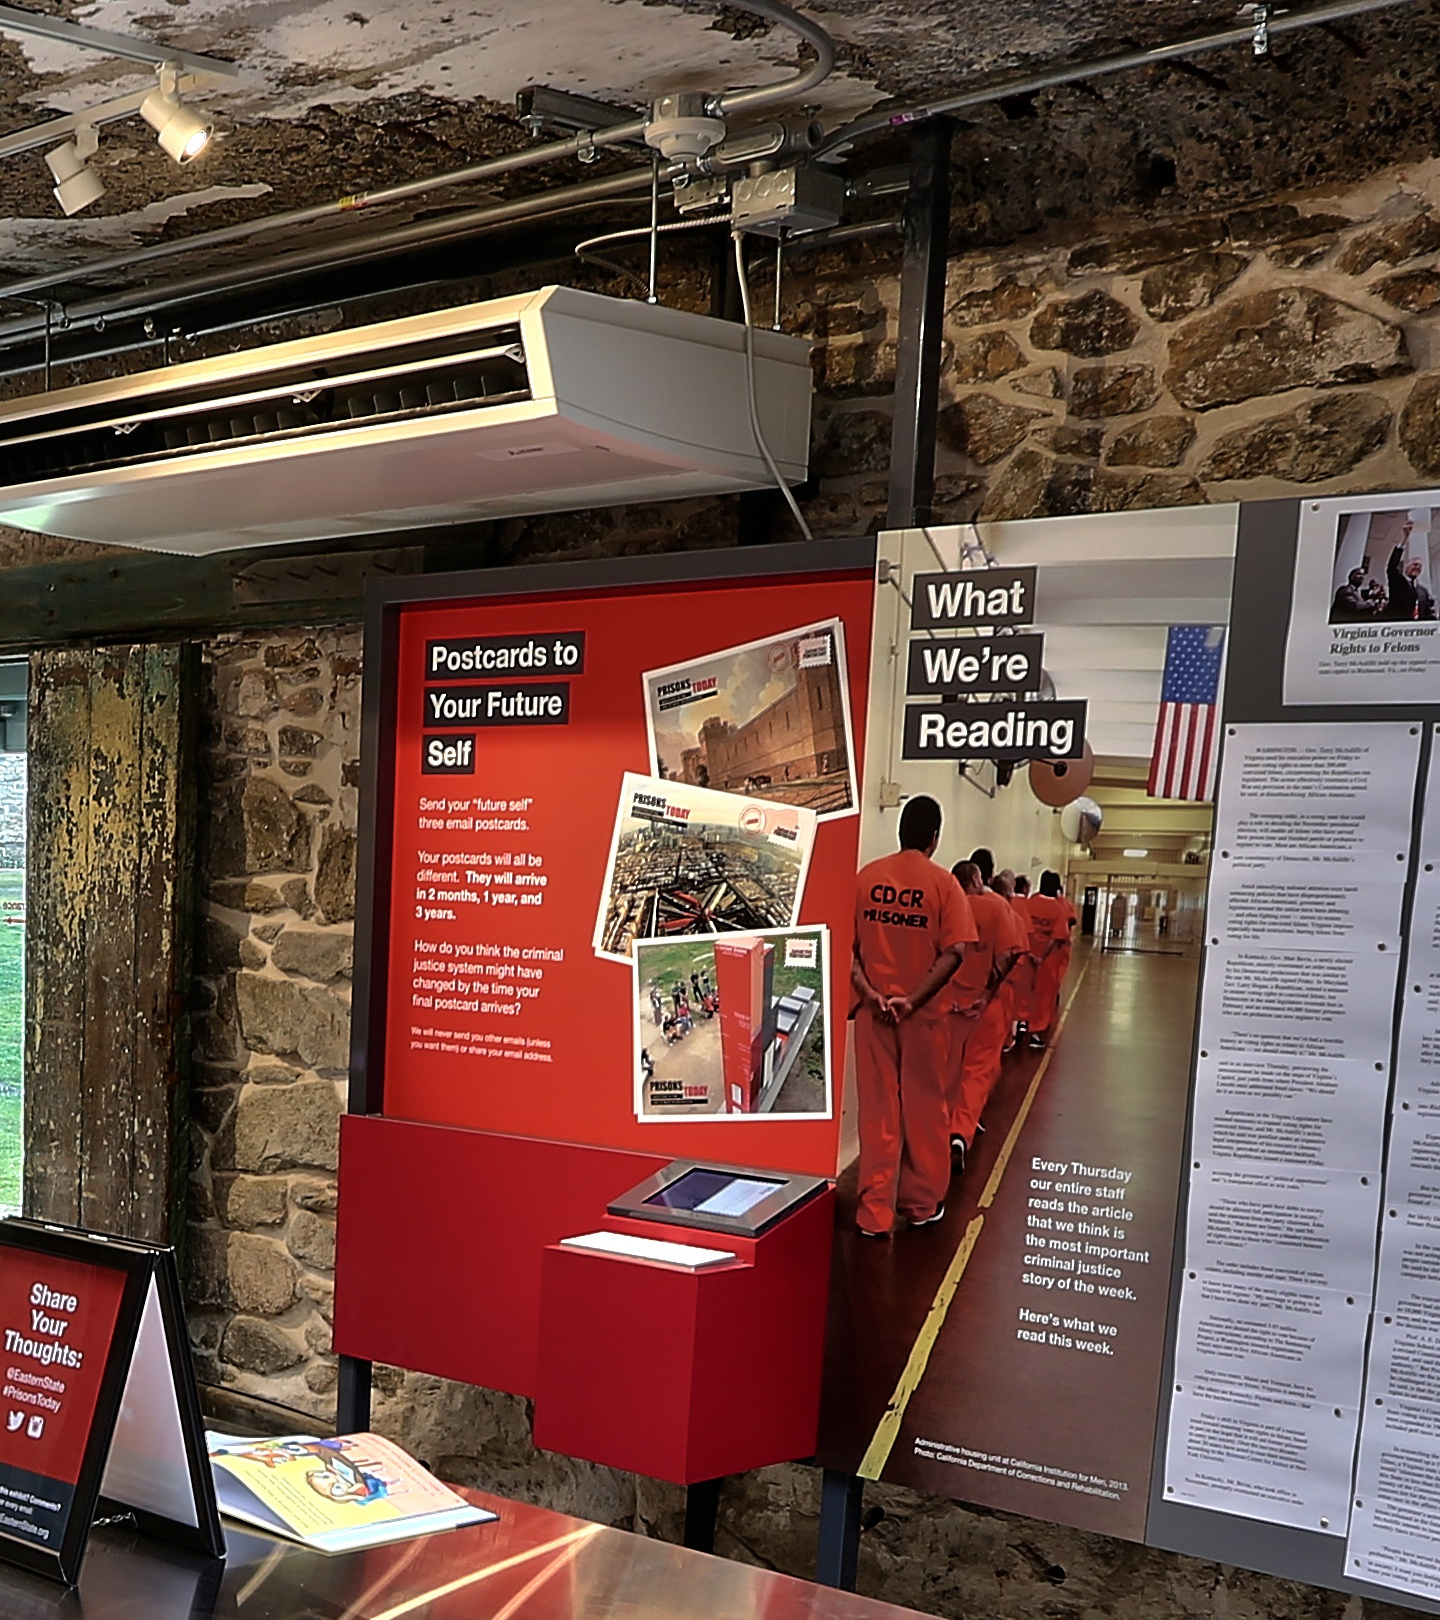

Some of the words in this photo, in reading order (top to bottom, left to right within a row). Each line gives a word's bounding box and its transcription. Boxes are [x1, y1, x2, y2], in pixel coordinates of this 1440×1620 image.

[927, 581, 1025, 618] What
[1332, 627, 1378, 641] Virginia
[1380, 625, 1437, 638] Governor
[432, 640, 547, 671] Postcards
[553, 640, 578, 666] to
[1330, 642, 1367, 656] Rights
[1369, 643, 1380, 653] to
[1383, 642, 1420, 653] Felons
[922, 646, 1029, 683] We're
[657, 678, 691, 697] PRISONS
[692, 676, 717, 694] TODAY
[430, 693, 481, 718] Your
[487, 691, 562, 717] Future
[918, 711, 1074, 755] Reading
[428, 740, 472, 766] Self
[420, 797, 446, 810] Send
[448, 800, 470, 814] your
[472, 798, 507, 811] "future
[509, 798, 533, 812] self"
[633, 792, 666, 809] PRISONS
[666, 804, 691, 820] TODAY
[419, 817, 444, 829] three
[446, 817, 473, 830] email
[475, 818, 529, 832] postcards.
[870, 884, 924, 908] CDCR
[864, 910, 928, 929] PRISONER
[650, 1080, 683, 1092] PRISONS
[684, 1085, 708, 1097] TODAY
[1032, 1157, 1068, 1176] Every
[1070, 1162, 1132, 1184] Thursday
[1030, 1179, 1052, 1190] our
[1054, 1182, 1092, 1196] entire
[1095, 1186, 1126, 1200] staff
[30, 1283, 77, 1312] Share
[31, 1309, 67, 1337] Your
[4, 1330, 82, 1368] Thoughts:
[6, 1367, 65, 1394] @EasternState
[2, 1385, 61, 1413] #PrisonsToday
